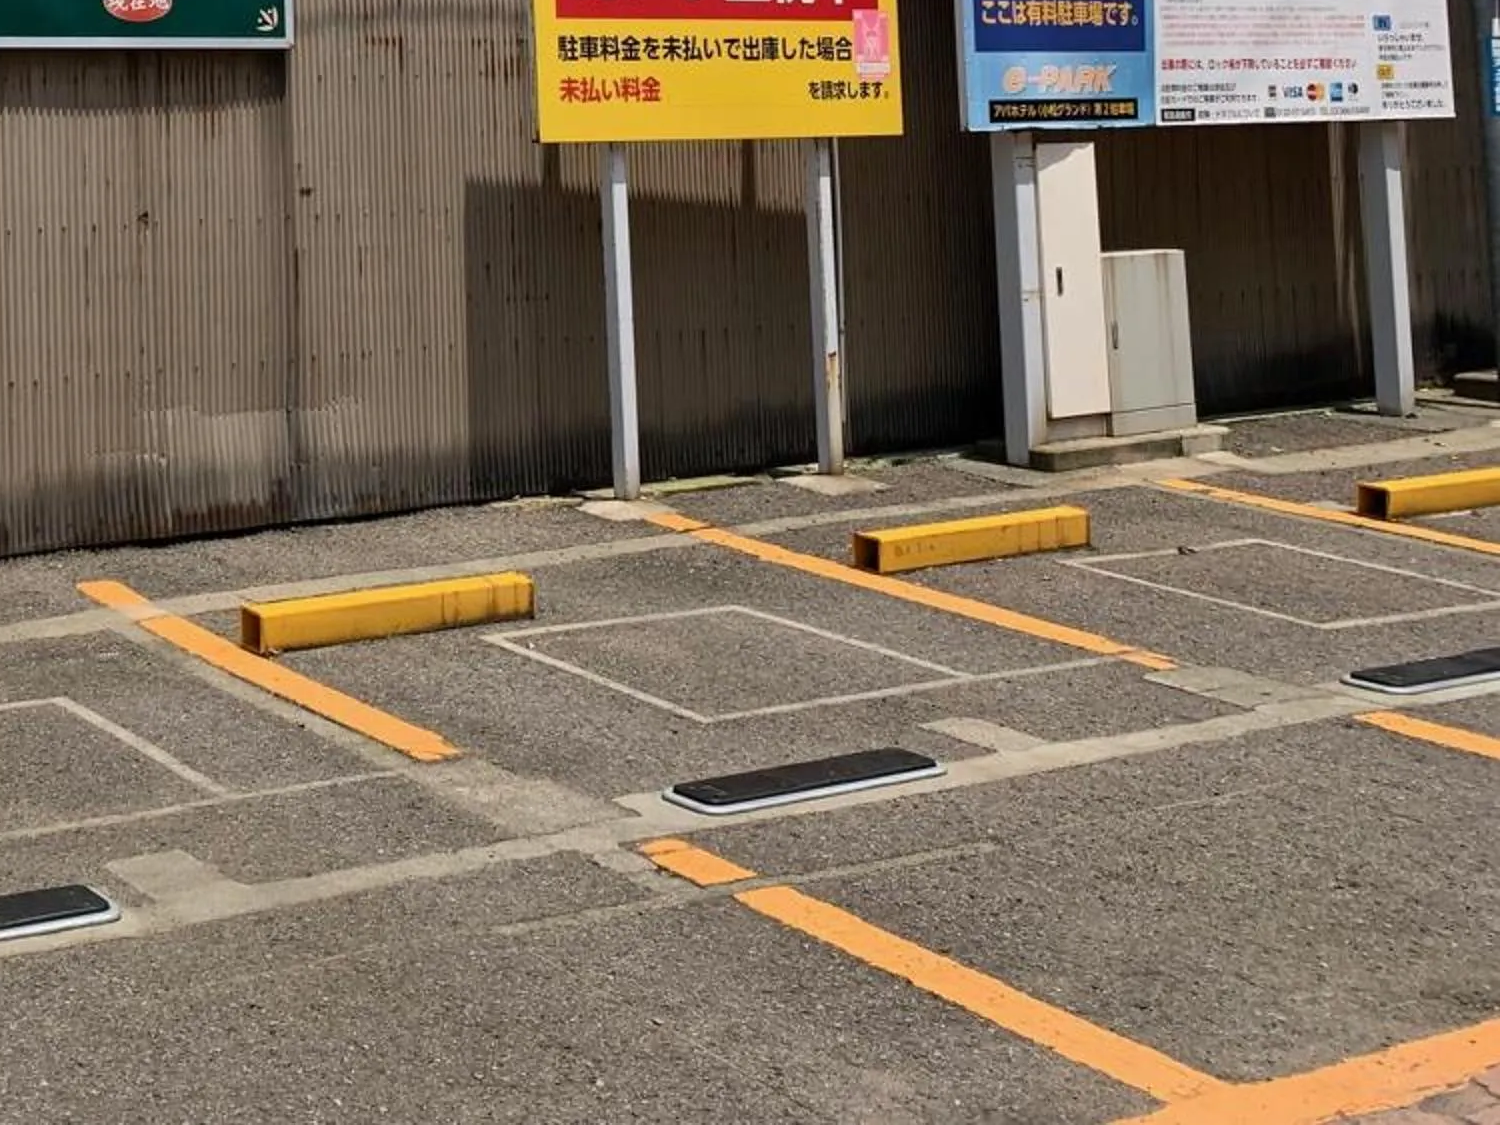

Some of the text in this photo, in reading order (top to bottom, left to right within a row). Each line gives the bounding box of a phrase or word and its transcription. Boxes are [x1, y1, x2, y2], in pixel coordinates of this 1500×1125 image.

[981, 0, 1139, 27] ここは有料駐車場です。
[557, 35, 853, 62] 駐車料金を未払いで出庫した場合
[559, 76, 661, 104] 未払い料金
[807, 80, 889, 101] を請求します。
